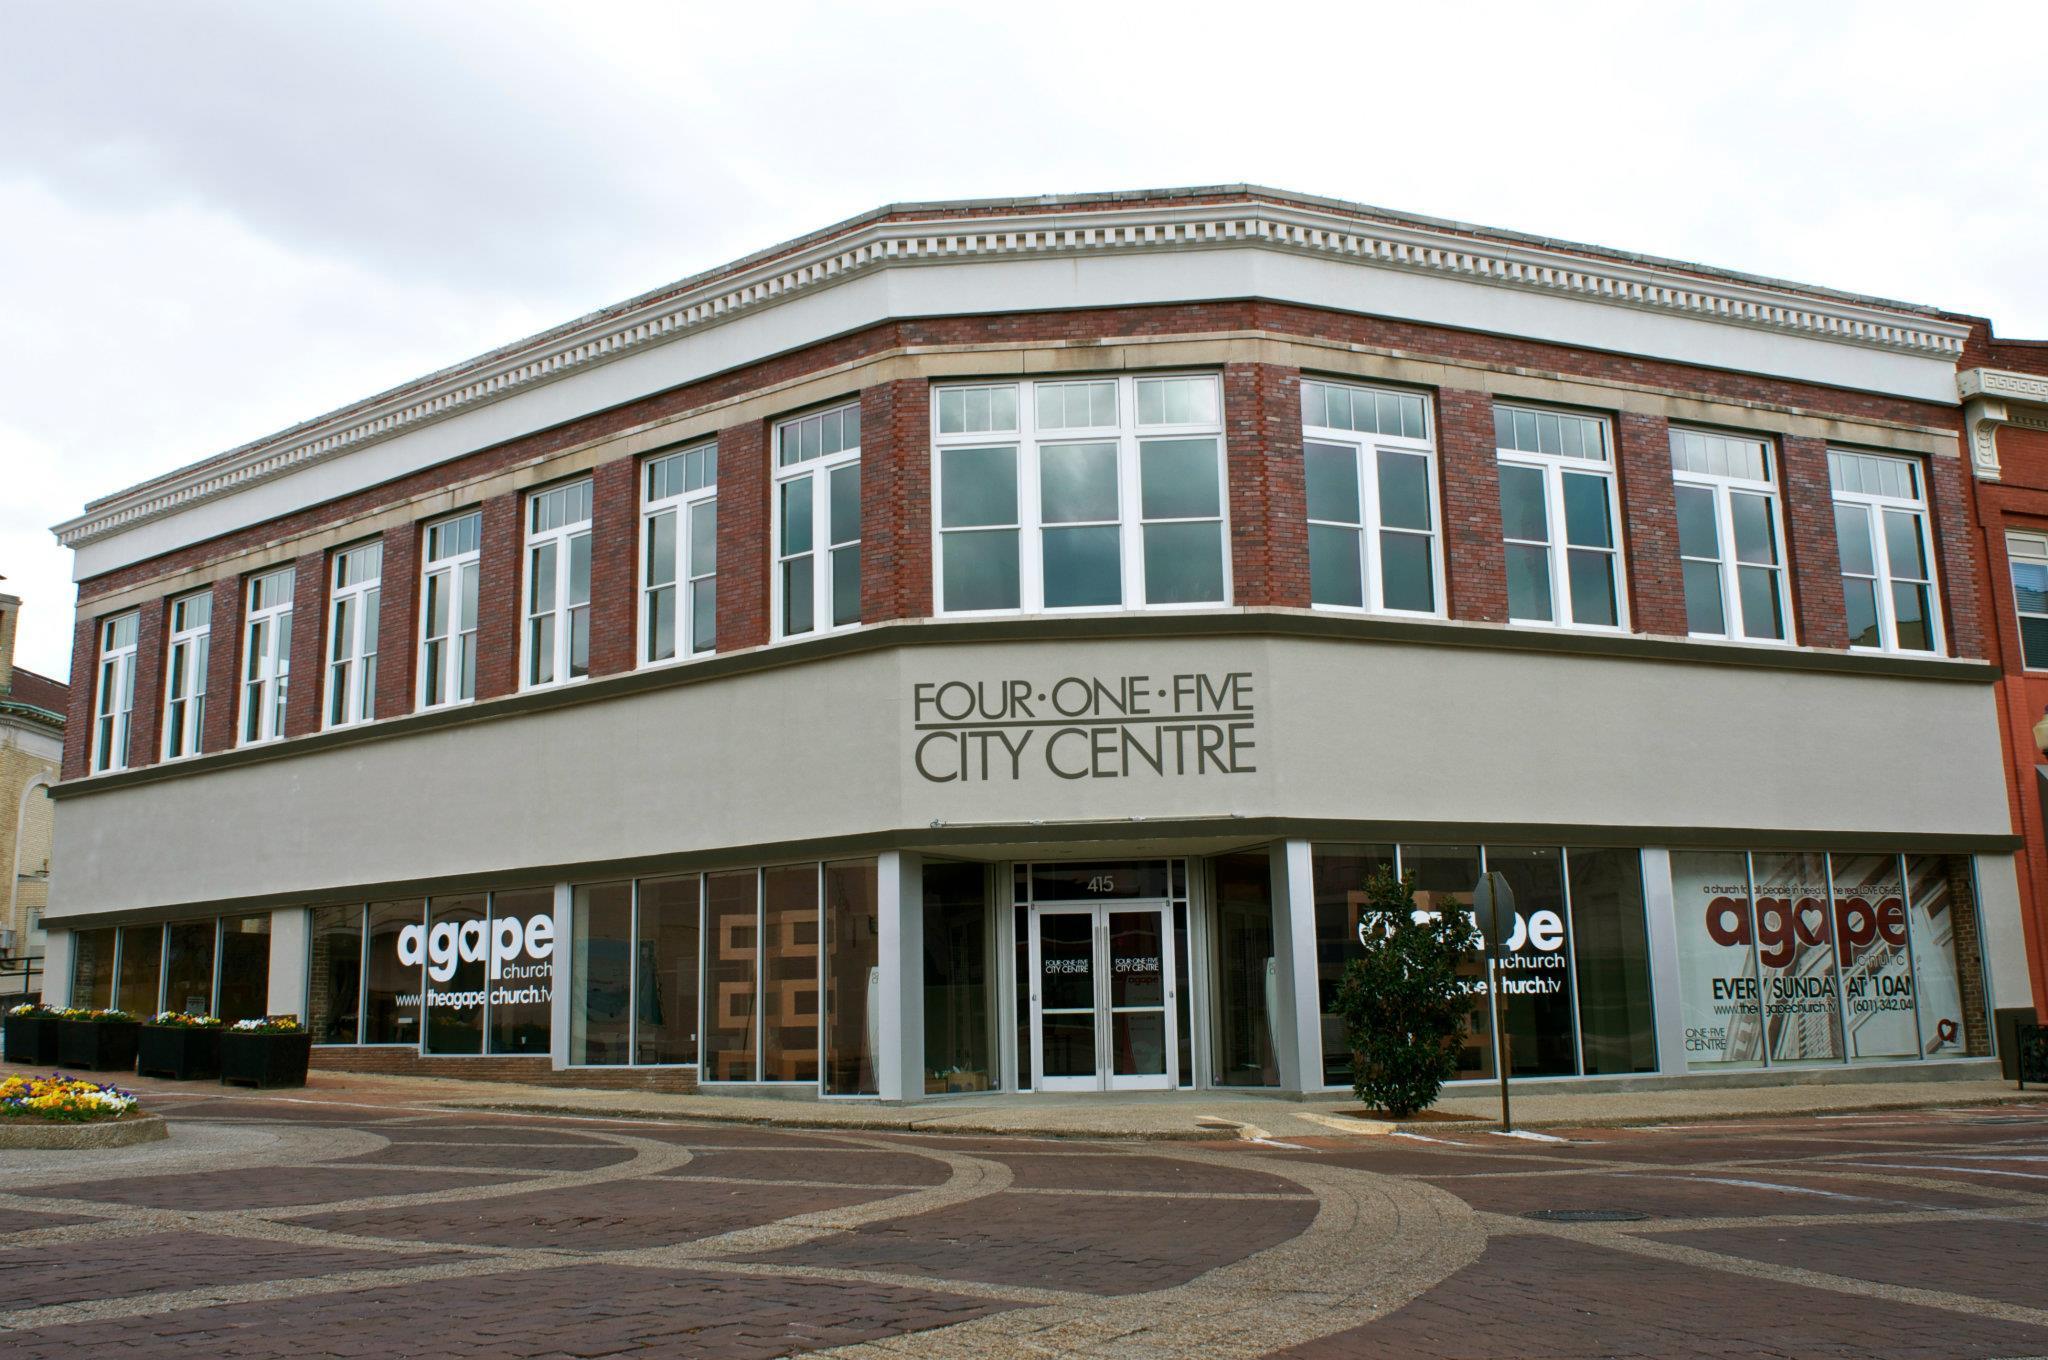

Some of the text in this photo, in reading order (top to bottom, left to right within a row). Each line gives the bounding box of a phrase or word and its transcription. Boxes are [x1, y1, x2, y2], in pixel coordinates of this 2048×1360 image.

[915, 722, 1257, 783] CITY CENTRE
[1087, 875, 1114, 893] 415
[1711, 885, 1740, 894] church
[1762, 885, 1790, 896] people
[1860, 886, 1877, 895] LOVE
[1705, 896, 1912, 969] agape
[397, 914, 554, 983] agape
[1115, 963, 1159, 972] CITY CENTRE
[1504, 953, 1565, 969] church
[1857, 954, 1908, 967] churc
[502, 961, 553, 979] church
[1045, 965, 1088, 974] CITY CENTRE
[1773, 976, 1838, 999] SUNDA
[1847, 975, 1866, 997] AT
[396, 984, 554, 1011] wwwtheagapechurch.tv
[1714, 1001, 1837, 1018] www.thegapechurch.tv
[1685, 1039, 1727, 1051] CENTRE
